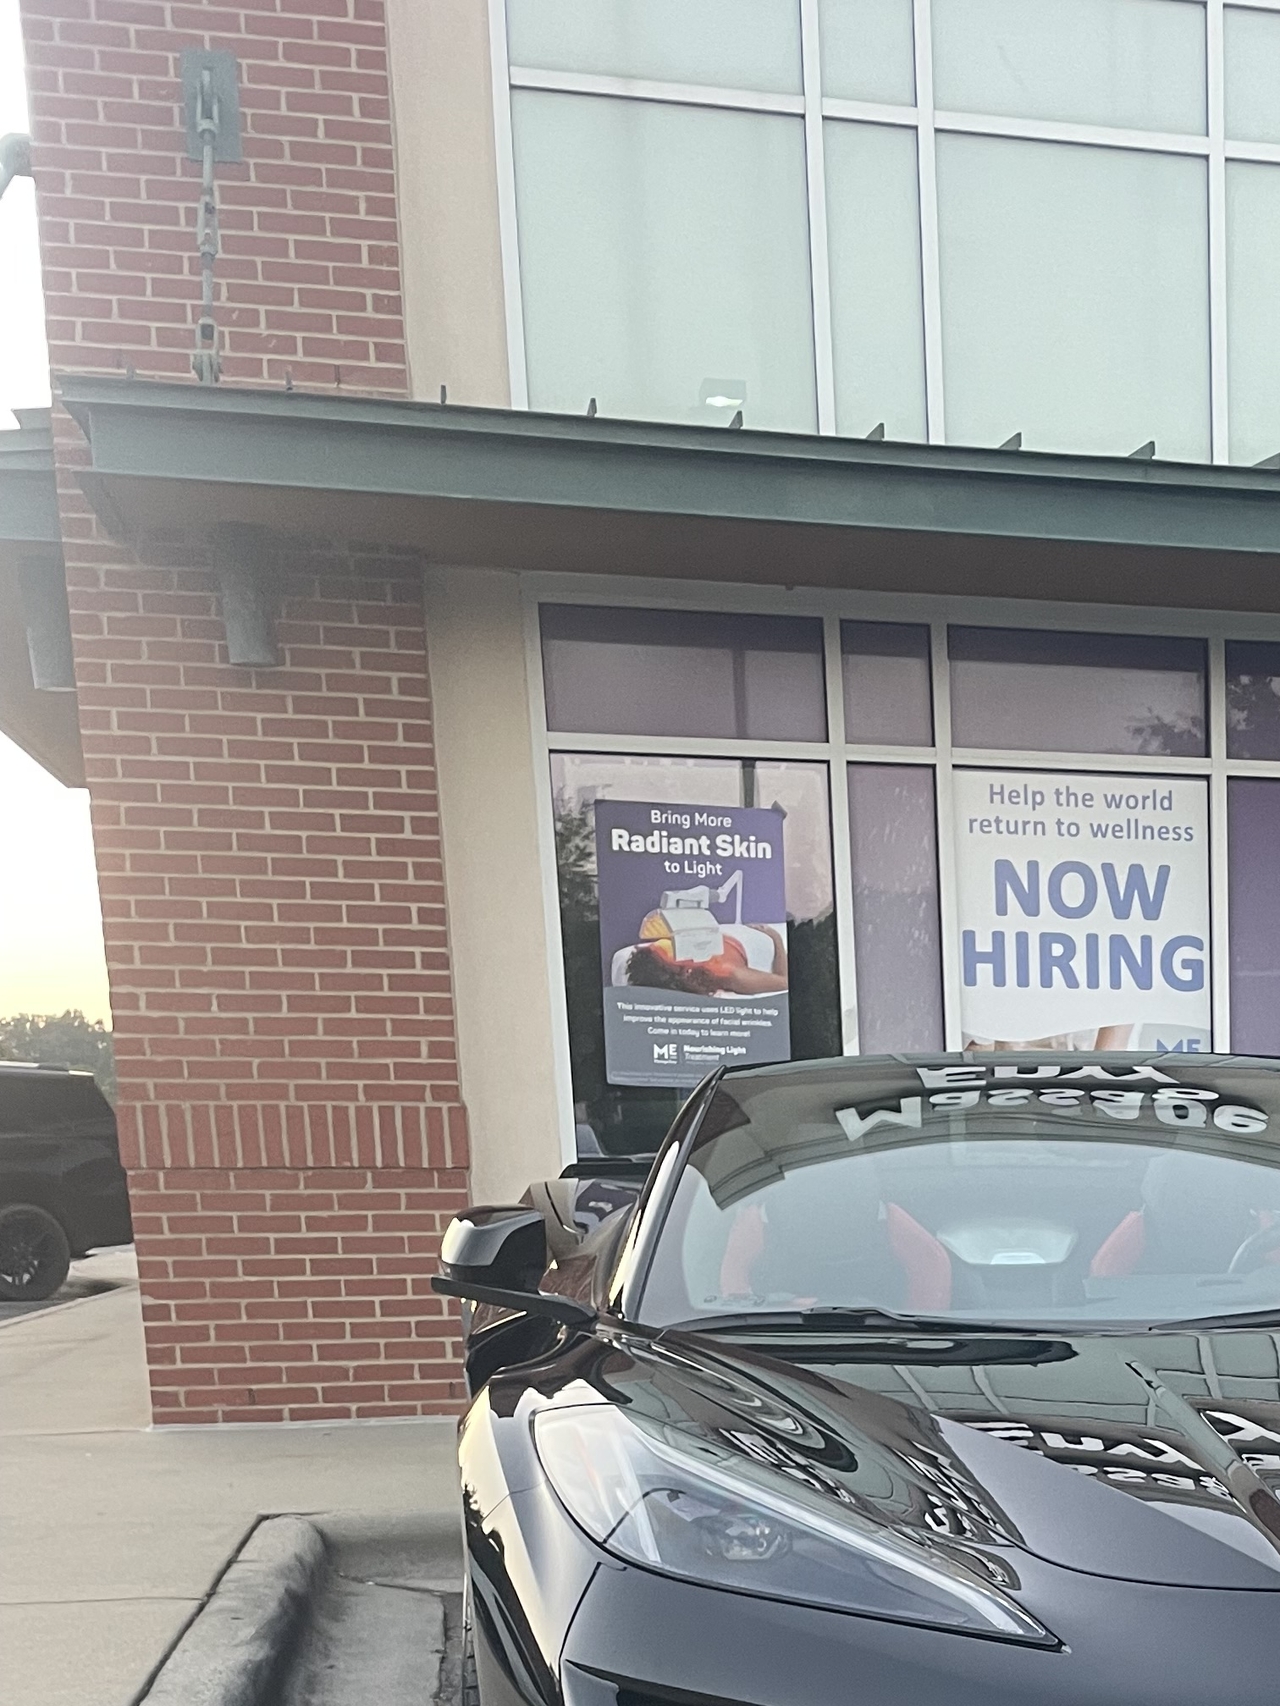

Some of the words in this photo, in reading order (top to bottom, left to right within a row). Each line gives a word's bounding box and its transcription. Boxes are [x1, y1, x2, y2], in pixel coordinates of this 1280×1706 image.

[989, 783, 1045, 811] Help
[1054, 786, 1095, 809] the
[1103, 789, 1173, 811] world
[650, 809, 690, 829] Bring
[694, 812, 732, 828] More
[968, 815, 1046, 837] return
[1055, 818, 1081, 838] to
[1089, 819, 1194, 842] wellness
[611, 828, 711, 856] Radiant
[716, 832, 772, 859] Skin
[664, 859, 681, 874] to
[684, 860, 723, 877] Light
[993, 858, 1171, 921] NOW
[961, 929, 1205, 992] HIRING
[654, 1015, 667, 1024] the
[719, 1005, 735, 1014] LED
[753, 1007, 761, 1015] to
[762, 1007, 779, 1017] help
[700, 1028, 709, 1036] to
[653, 1043, 678, 1059] ME
[726, 1045, 747, 1055] Light
